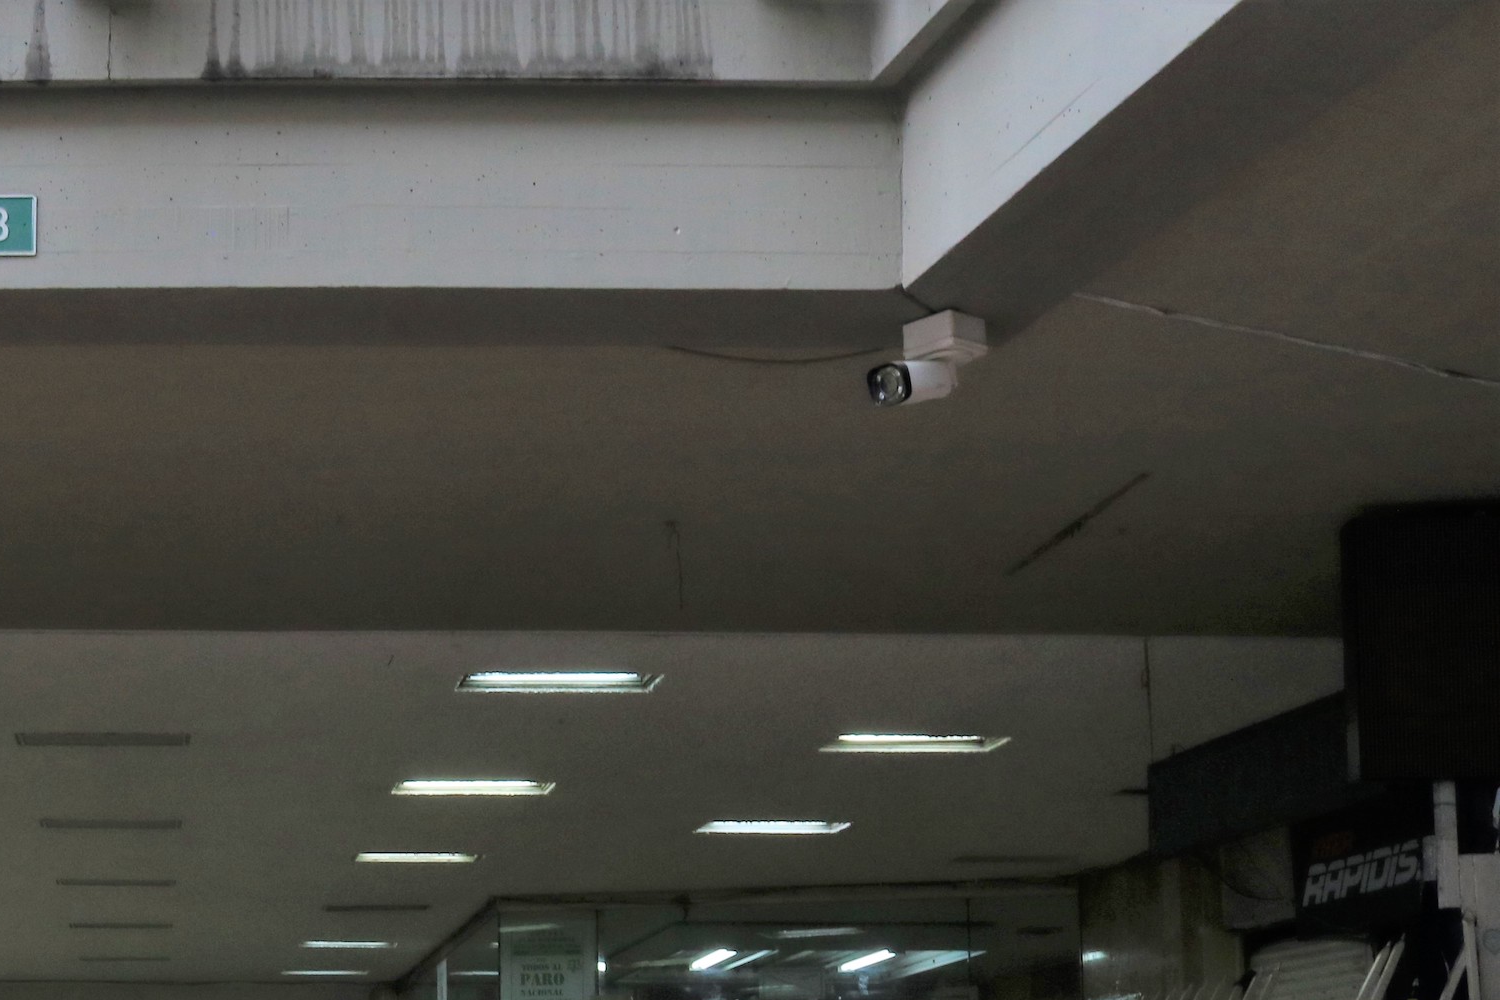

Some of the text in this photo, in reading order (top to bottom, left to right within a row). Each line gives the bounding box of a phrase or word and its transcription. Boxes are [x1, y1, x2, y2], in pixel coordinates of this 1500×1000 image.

[1301, 838, 1421, 908] RAPIDIS
[520, 973, 566, 986] PARO
[520, 988, 565, 997] NACIONAL
